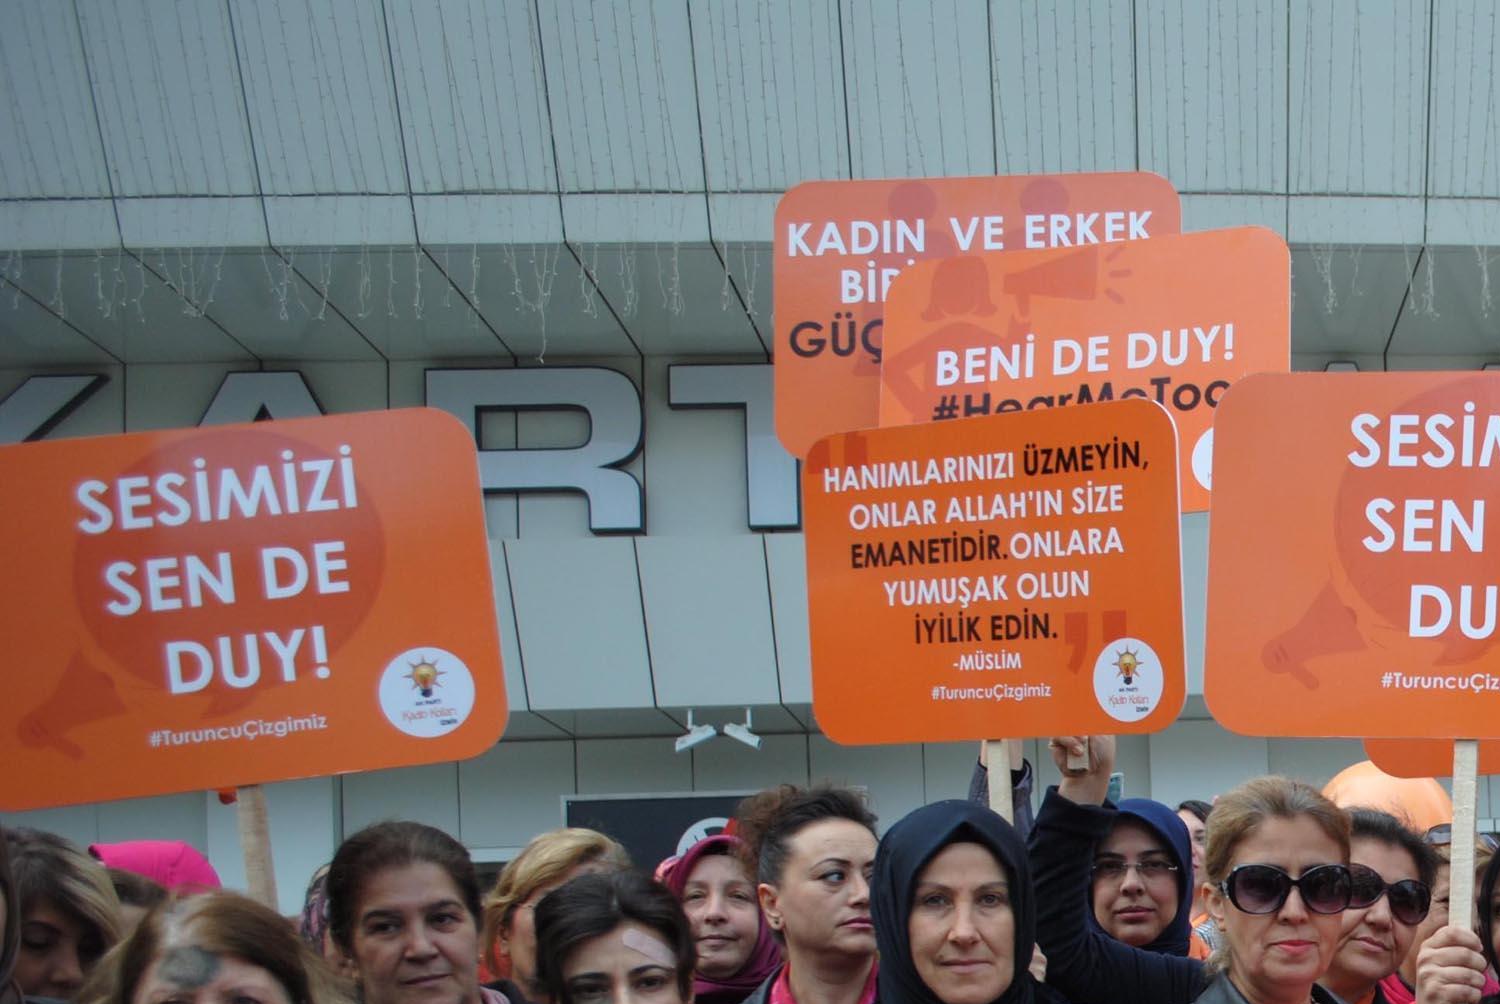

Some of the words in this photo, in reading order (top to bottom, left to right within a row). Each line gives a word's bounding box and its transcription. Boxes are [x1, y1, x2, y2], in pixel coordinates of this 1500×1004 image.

[787, 218, 926, 257] KADIN
[949, 215, 1004, 251] VE
[1025, 210, 1152, 247] ERKEK
[936, 332, 1036, 387] BENİ
[1051, 332, 1112, 376] DE
[1124, 320, 1238, 372] DUY!
[75, 442, 358, 534] SESİMİZİ
[824, 453, 1014, 492] HANIMLARINIZI
[1024, 437, 1147, 475] ÜZMEYİN,
[849, 499, 936, 530] ONLAR
[946, 490, 1062, 522] ALLAH'IN
[1072, 481, 1123, 514] SİZE
[1362, 497, 1487, 553] SEN
[104, 552, 235, 615] SEN
[260, 541, 349, 599] DE
[884, 575, 1008, 608] YUMUŞAK
[1017, 570, 1089, 599] OLUN
[916, 612, 980, 643] İYİLİK
[991, 608, 1056, 640] EDİN.
[165, 625, 330, 694] DUY!
[954, 650, 1021, 670] -MÜSLİM
[932, 683, 1051, 701] #TuruncuÇizgimiz
[150, 714, 327, 746] #TuruncuÇizgimiz
